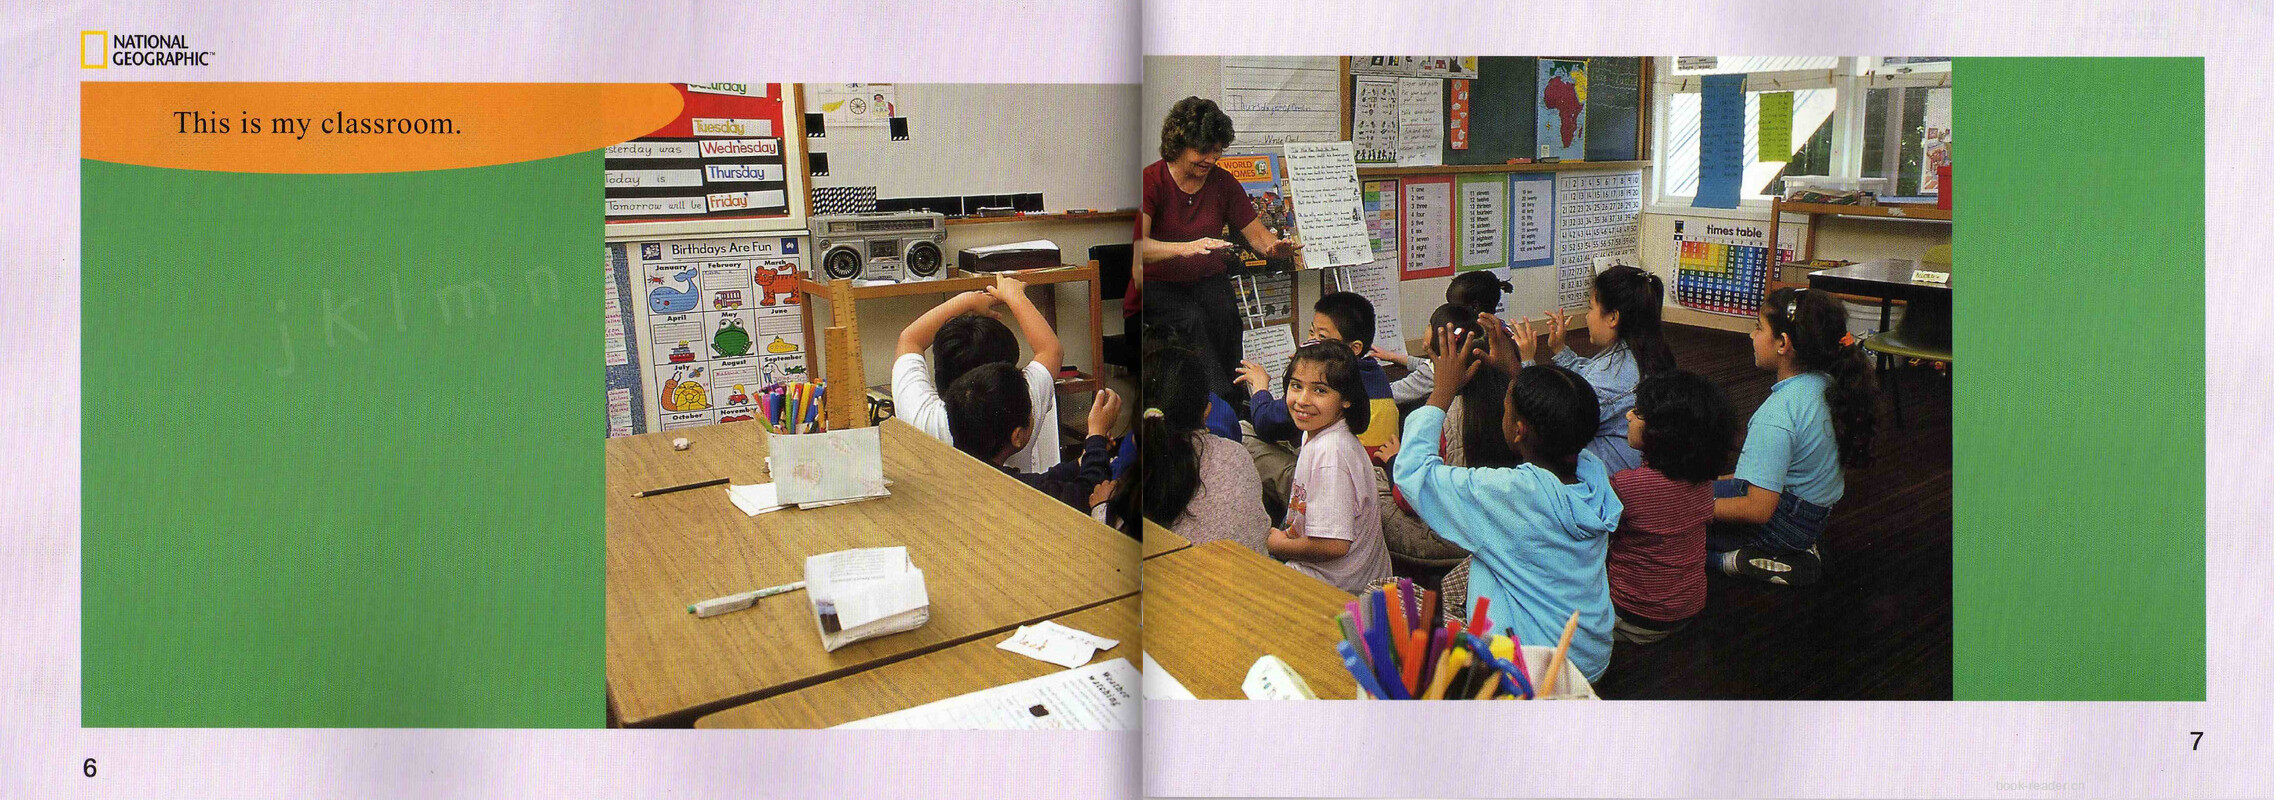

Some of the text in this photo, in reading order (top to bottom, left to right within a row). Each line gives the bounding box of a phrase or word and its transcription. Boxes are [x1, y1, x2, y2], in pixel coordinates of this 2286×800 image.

[114, 35, 189, 49] NATIONAL
[173, 111, 461, 140] This is my classroom.
[694, 119, 745, 135] Tuesday
[703, 140, 776, 154] Wednesday
[1224, 161, 1252, 169] WORLD
[605, 173, 666, 186] Today is
[708, 166, 765, 180] Thursday
[609, 201, 662, 211] Tomorrow
[709, 194, 748, 208] Friday
[1707, 225, 1762, 238] times table
[672, 242, 772, 255] Birthdays Are Fun
[674, 364, 690, 372] July
[1103, 671, 1130, 698] Weather
[2190, 732, 2204, 751] 7
[83, 758, 97, 778] 6
